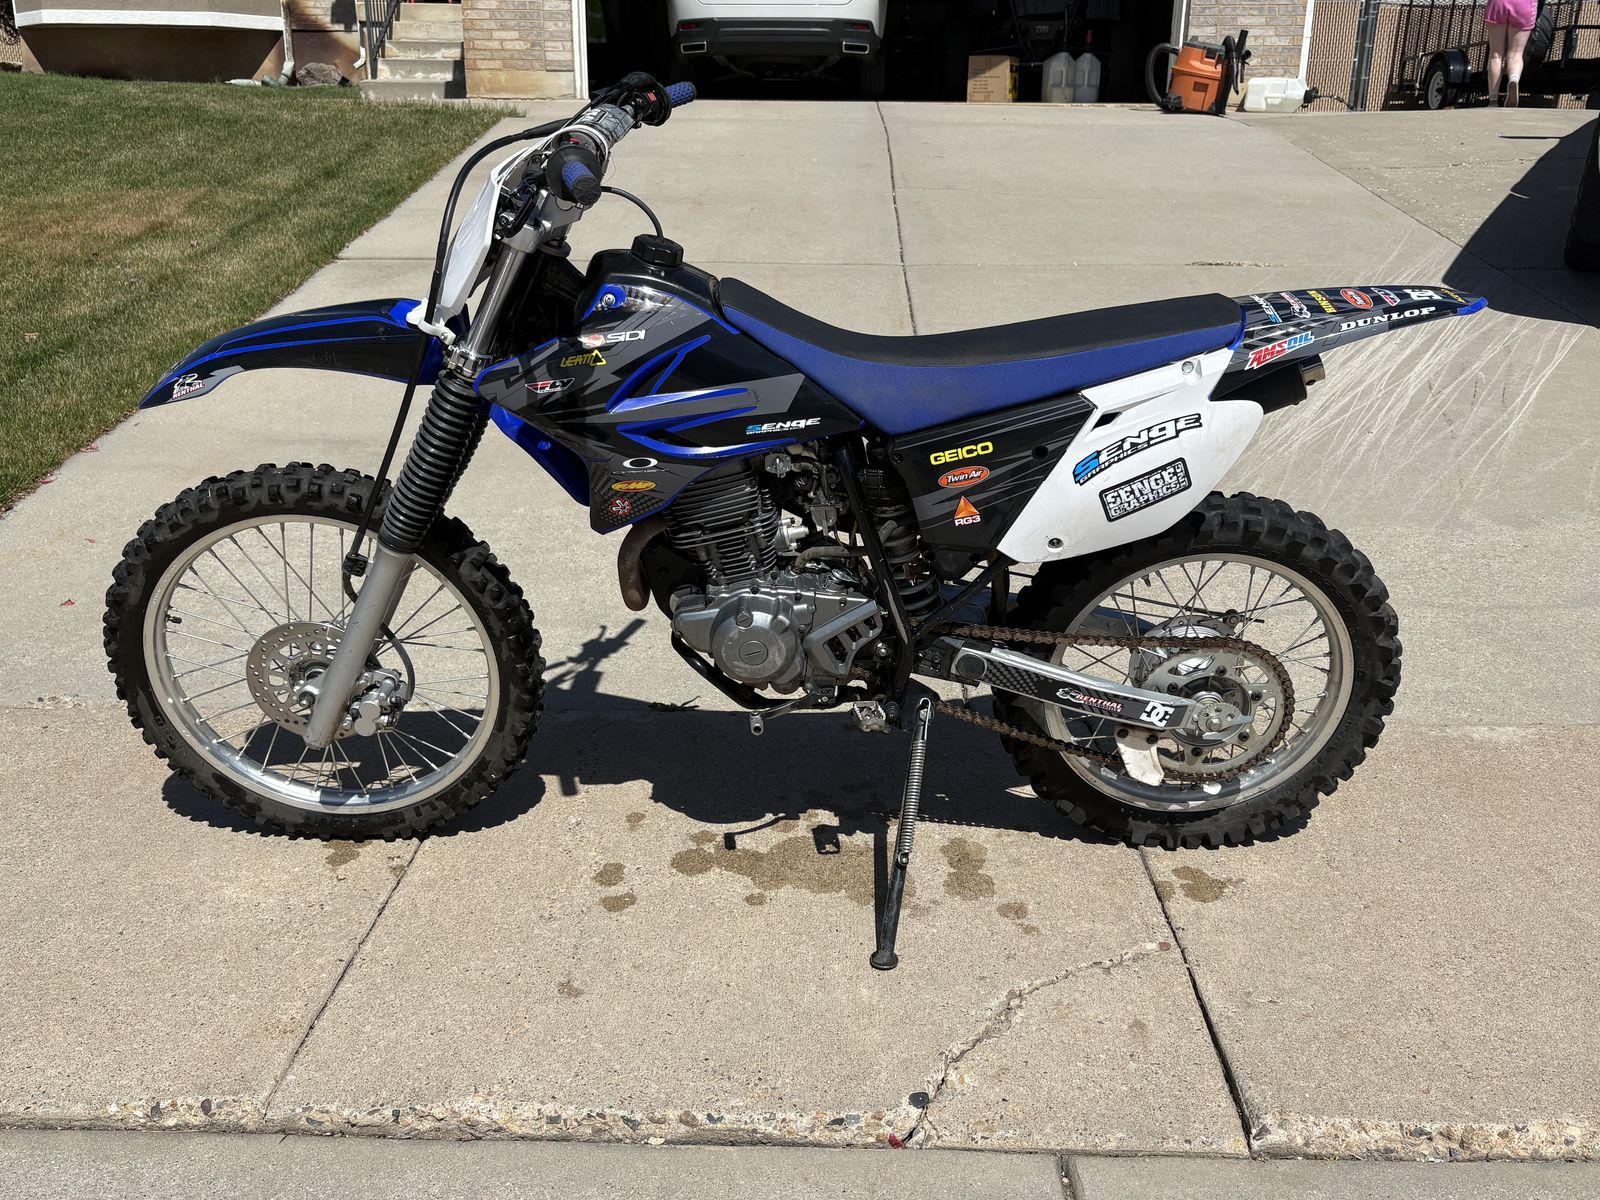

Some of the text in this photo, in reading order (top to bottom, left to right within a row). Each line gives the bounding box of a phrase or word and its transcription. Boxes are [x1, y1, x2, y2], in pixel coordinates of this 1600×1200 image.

[1340, 306, 1437, 331] DUNLOP
[1244, 331, 1315, 370] AMSOIL
[172, 383, 205, 399] RENTHAL
[929, 441, 994, 466] GEICO
[947, 470, 983, 483] Twin Air
[1105, 464, 1180, 508] SENGE
[954, 514, 981, 527] RG3
[1074, 692, 1124, 710] RENTHAL
